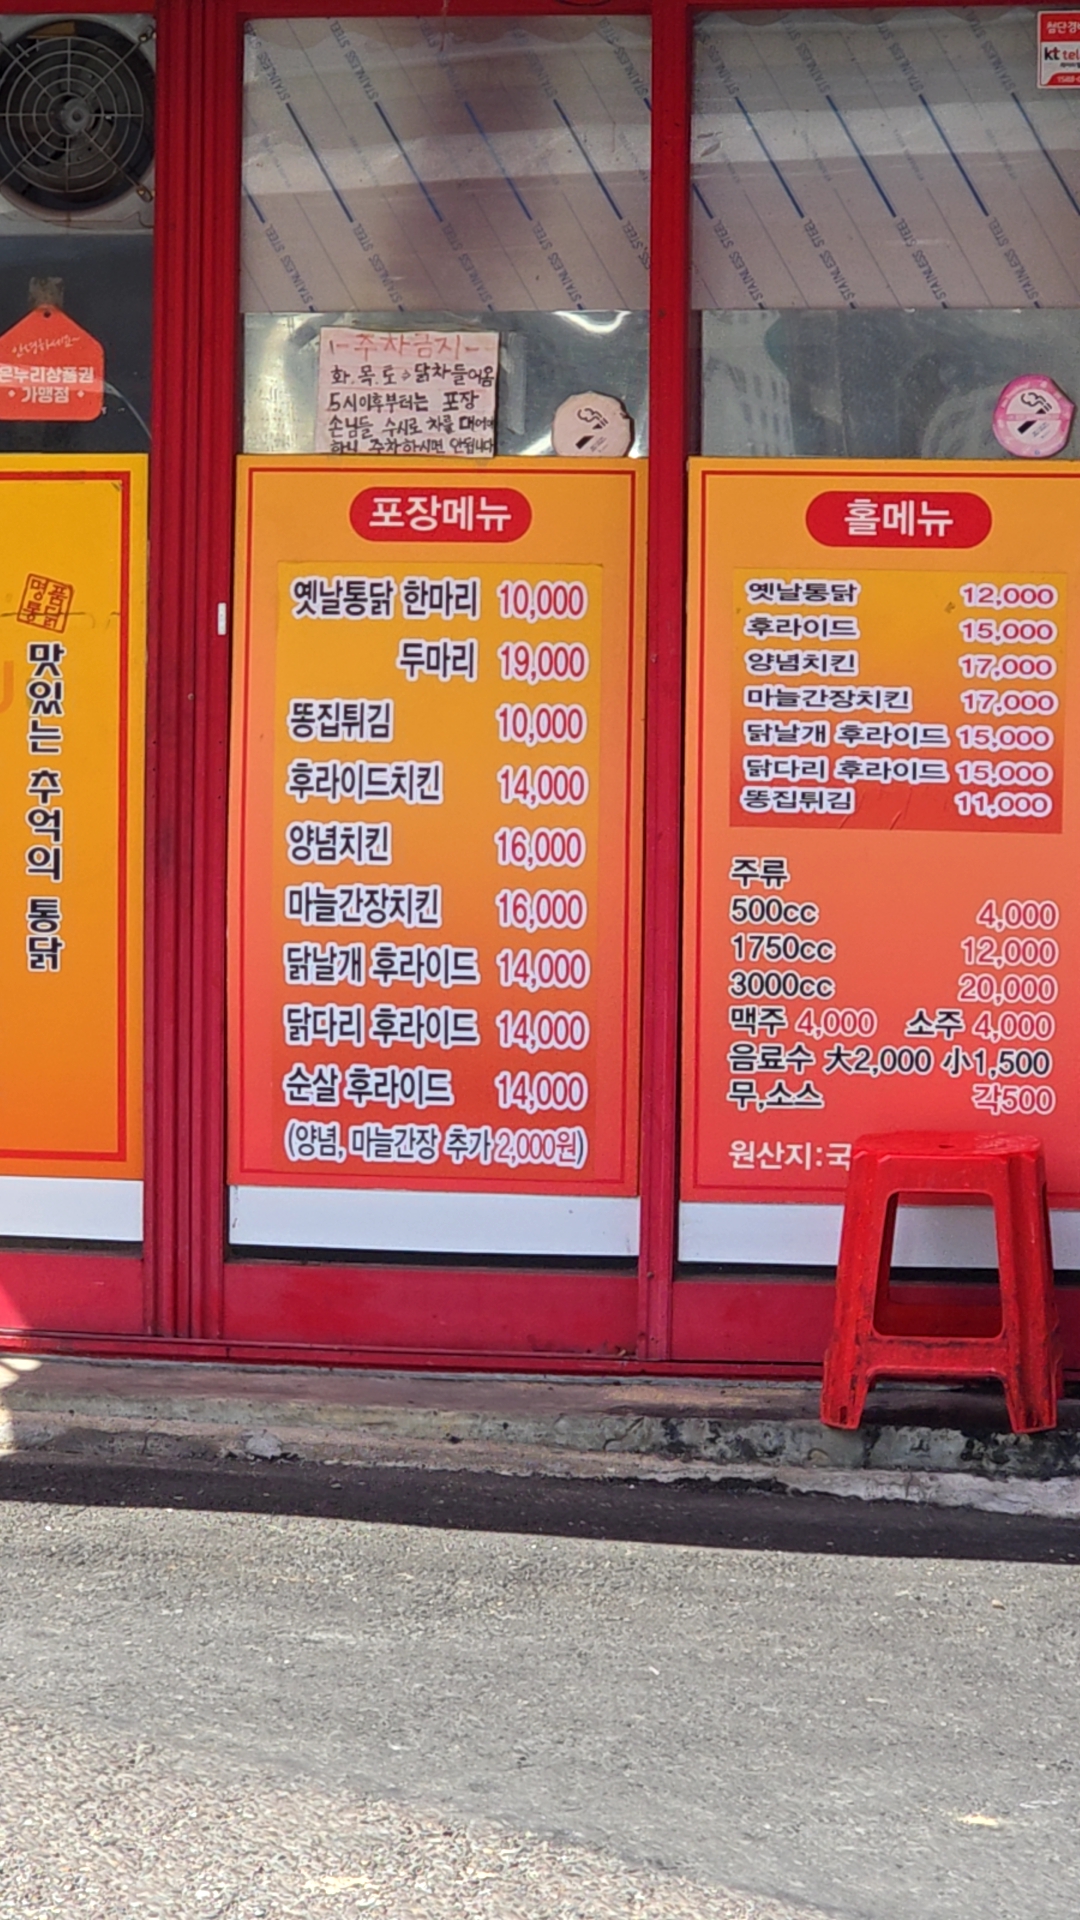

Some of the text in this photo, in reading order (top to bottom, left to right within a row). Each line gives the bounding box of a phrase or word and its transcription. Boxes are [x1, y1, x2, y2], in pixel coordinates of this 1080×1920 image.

[330, 20, 379, 100] STAINLESS STEEL
[614, 47, 649, 97] STAINLESS
[798, 43, 831, 93] STAINLESS
[888, 42, 924, 93] STAINLESS
[981, 40, 1016, 91] STAINLESS
[1044, 47, 1060, 60] kt
[622, 220, 643, 249] STEEL
[265, 224, 314, 304] STAINLESS STEEL
[353, 223, 403, 303] STAINLESS STEEL
[442, 222, 492, 302] STAINLESS STEEL
[533, 221, 582, 302] STAINLESS STEEL
[713, 219, 763, 301] STAINLESS STEEL
[803, 219, 854, 301] STAINLESS STEEL
[896, 218, 946, 300] STAINLESS STEEL
[989, 217, 1039, 300] STAINLESS STEEL
[21, 386, 69, 403] 가맹점
[442, 390, 479, 412] 포장
[328, 414, 374, 440] 손님들
[382, 417, 422, 437] 수시로
[368, 495, 513, 532] 포장메뉴
[844, 498, 954, 536] 홀메뉴
[292, 579, 585, 619] 옛날통닭 한마리 10,000
[748, 582, 1054, 606] 옛날통닭 12,000
[747, 618, 1053, 642] 후라이드 15,000
[400, 641, 585, 681] 두마리 19,000
[748, 653, 1052, 677] 양념치킨 17,000
[747, 688, 1054, 713] 마늘간장치킨 17,000
[291, 702, 584, 743] 똥집튀김 10,000
[747, 723, 1049, 748] 닭날개 후라이드 15,000
[290, 763, 585, 804] 후라이드치킨 14,000
[747, 758, 1049, 783] 닭다리 후라이드 15,000
[27, 643, 65, 970] 맛있는 추억의 통닭
[743, 790, 1048, 815] 똥집튀김 11,000
[289, 824, 582, 867] 양념치킨 16,000
[731, 859, 788, 887] 주류
[289, 887, 583, 928] 마늘간장치킨 16,000
[731, 898, 1056, 929] 500cc 4,000
[287, 945, 586, 988] 닭날개 후라이드 14,000
[733, 935, 1056, 966] 1750cc 12,000
[731, 972, 1056, 1003] 3000cc 20,000
[287, 1006, 586, 1049] 닭다리 후라이드 14,000
[731, 1006, 1053, 1041] 맥주 4,000 소주 4,000
[729, 1044, 814, 1072] 음료수
[286, 1066, 585, 1110] 순살 후라이드 14,000
[974, 1085, 1054, 1113] 각500
[352, 1125, 438, 1162] 마늘간장
